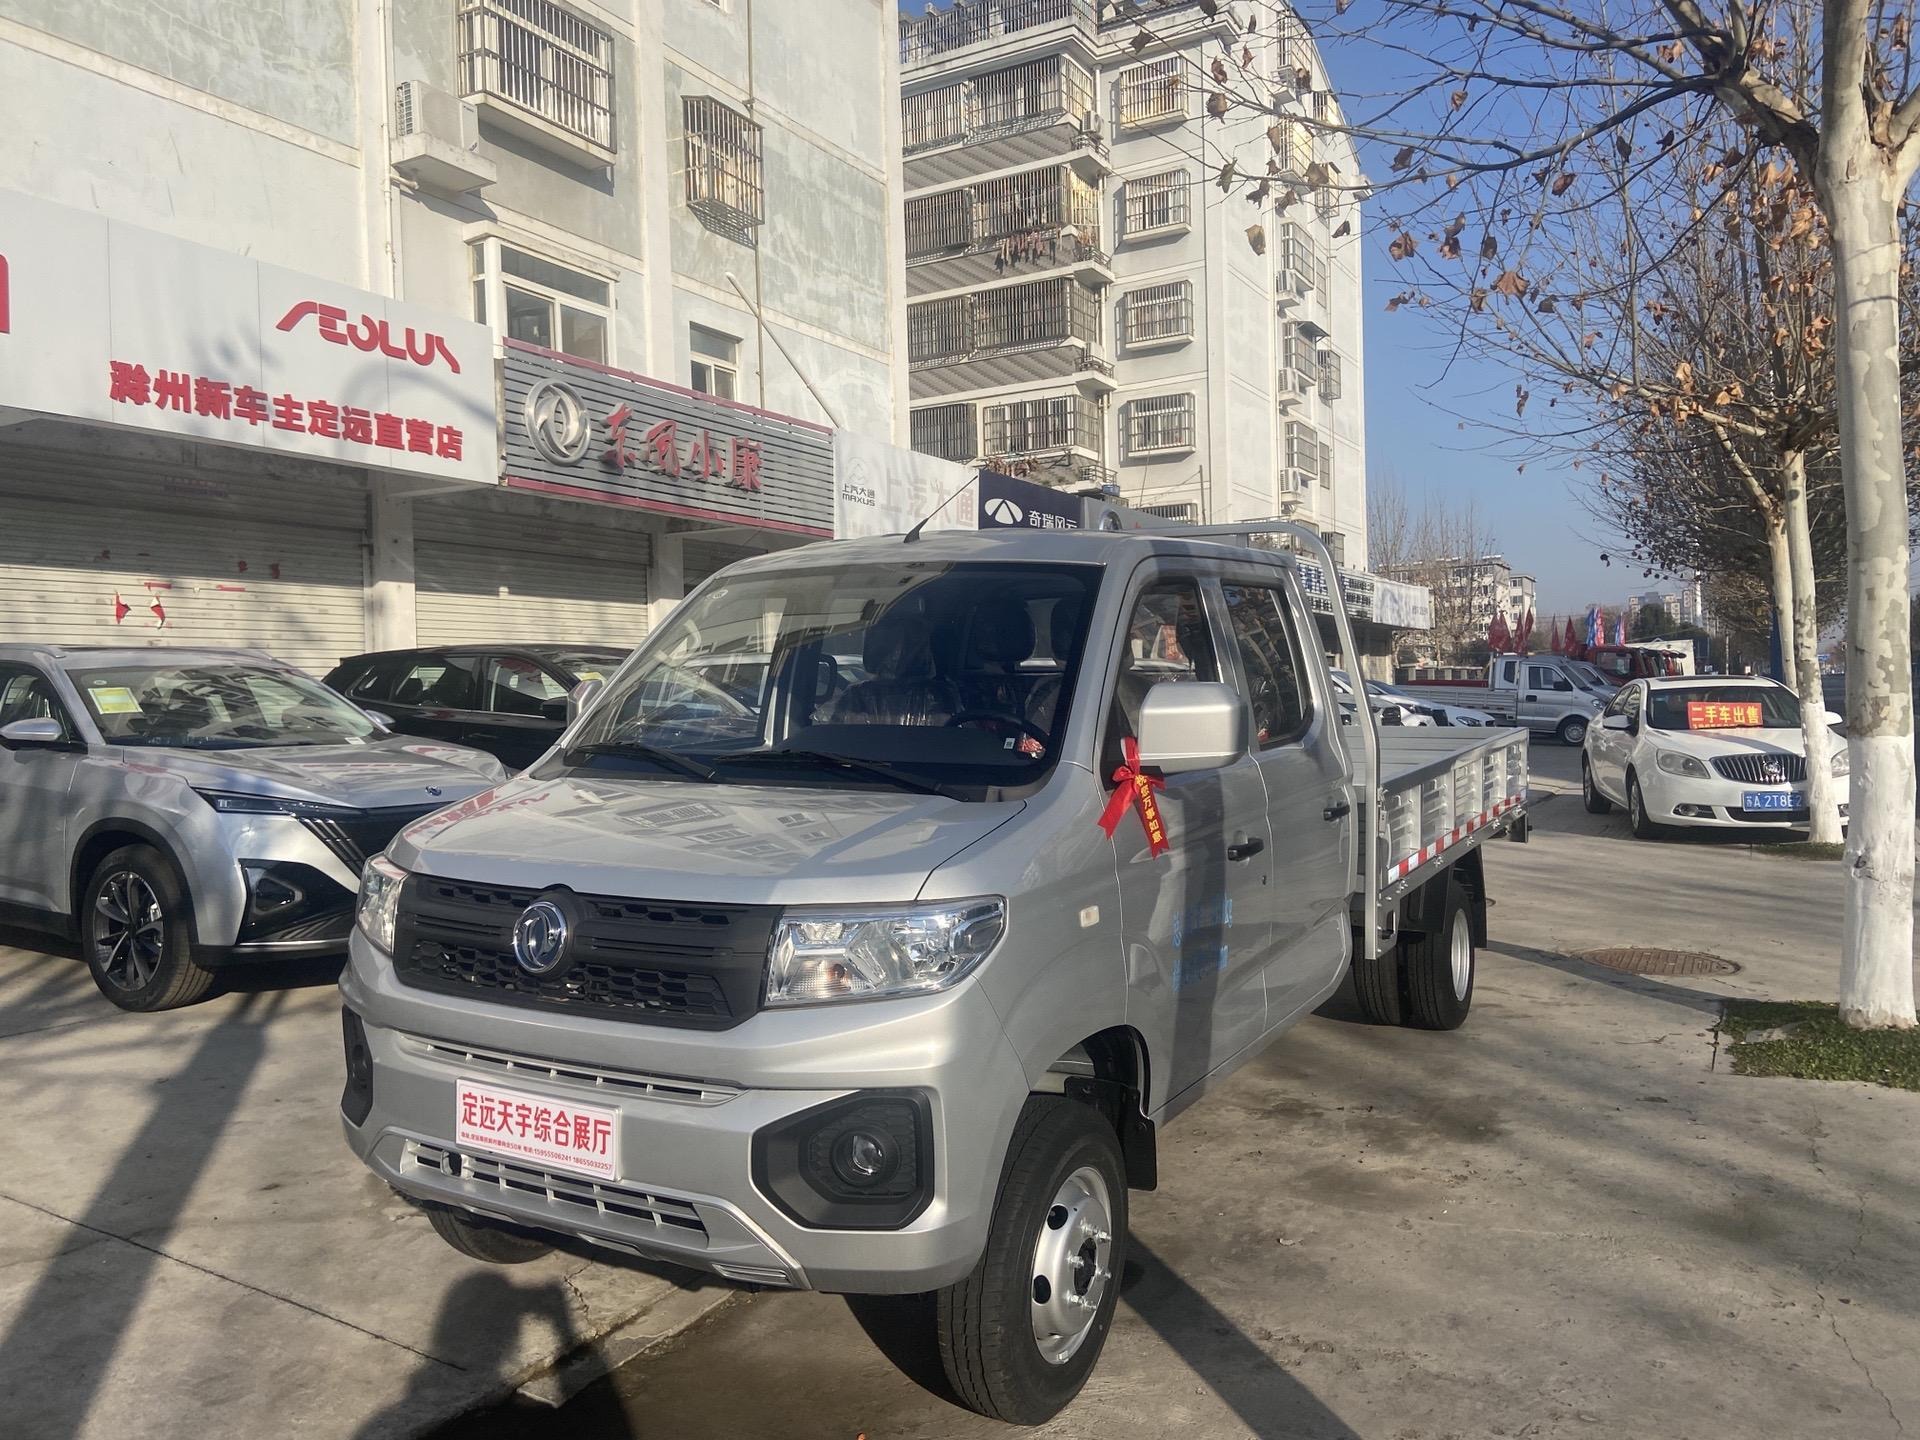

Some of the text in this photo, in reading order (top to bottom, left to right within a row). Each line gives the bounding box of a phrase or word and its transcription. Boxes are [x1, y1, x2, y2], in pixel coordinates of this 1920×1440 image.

[276, 301, 460, 374] AEOLUS
[110, 361, 463, 460] 滁州新车主定远直营店
[599, 403, 763, 491] 东风小康
[842, 483, 875, 499] 上汽大通
[842, 493, 875, 507] MAXUS
[1028, 510, 1078, 529] 奇瑞风云
[1692, 705, 1759, 724] 二手车出售
[462, 1092, 611, 1155] 定远天宇综合展厅
